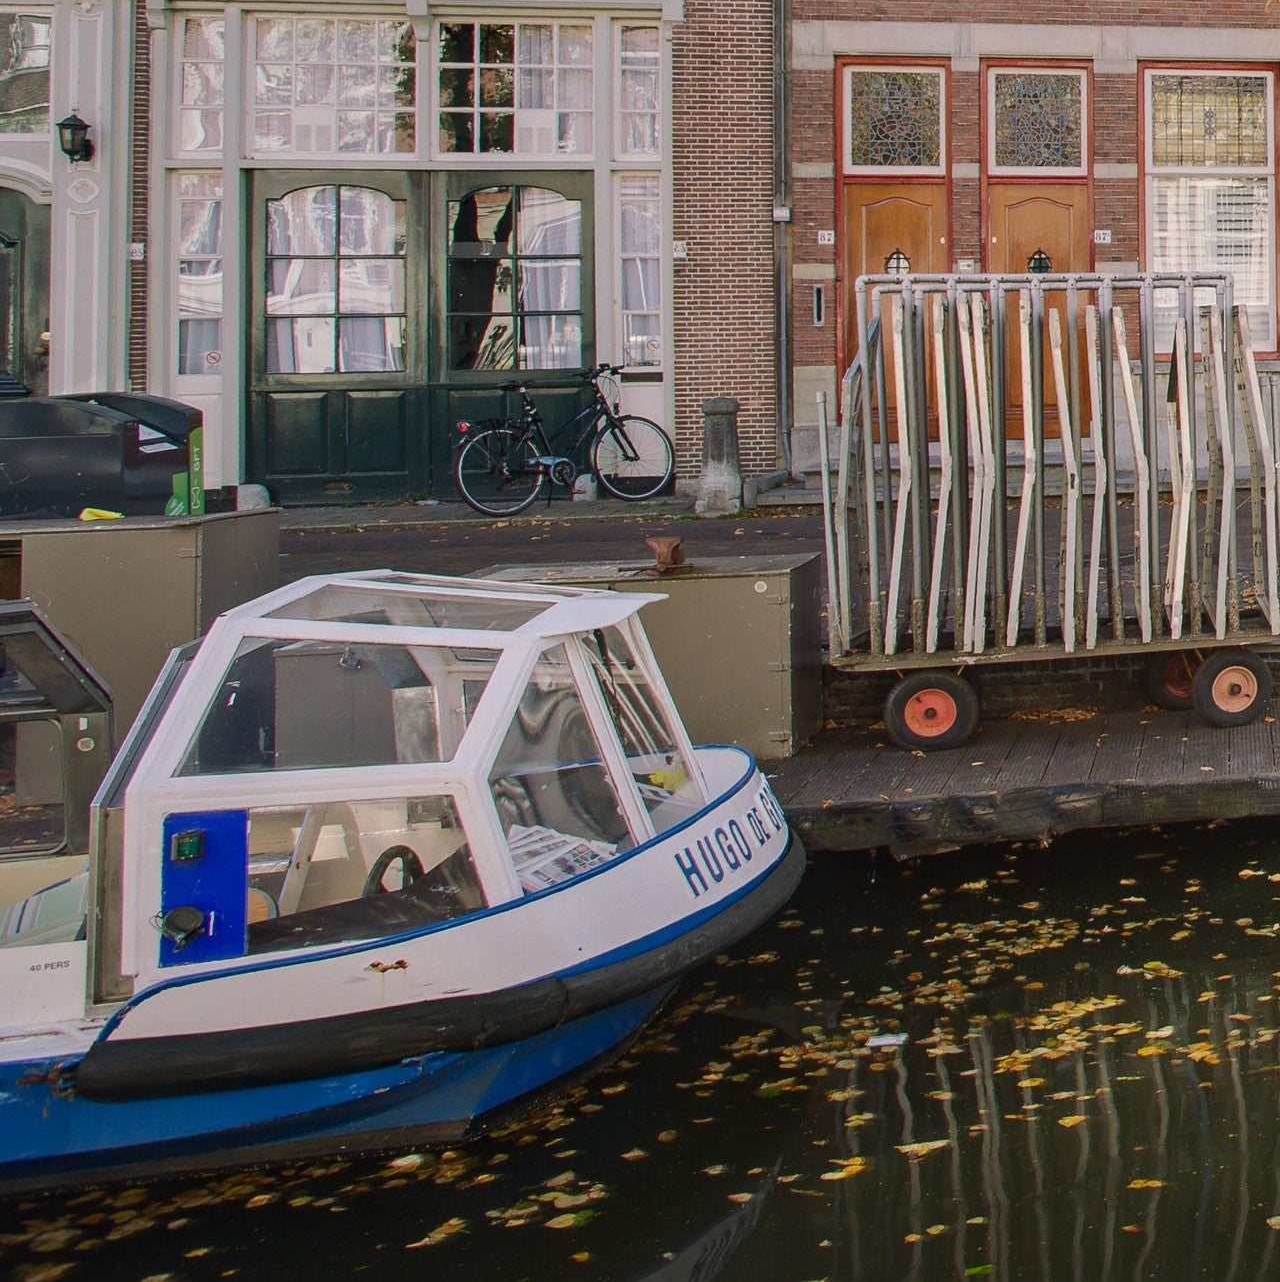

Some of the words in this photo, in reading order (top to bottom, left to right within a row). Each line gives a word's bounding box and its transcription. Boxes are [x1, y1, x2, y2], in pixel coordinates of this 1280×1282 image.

[819, 232, 832, 242] 87
[193, 445, 201, 472] GFT
[674, 818, 753, 897] HUGO
[746, 807, 772, 846] DE
[29, 964, 42, 972] 40
[44, 960, 71, 970] PERS
